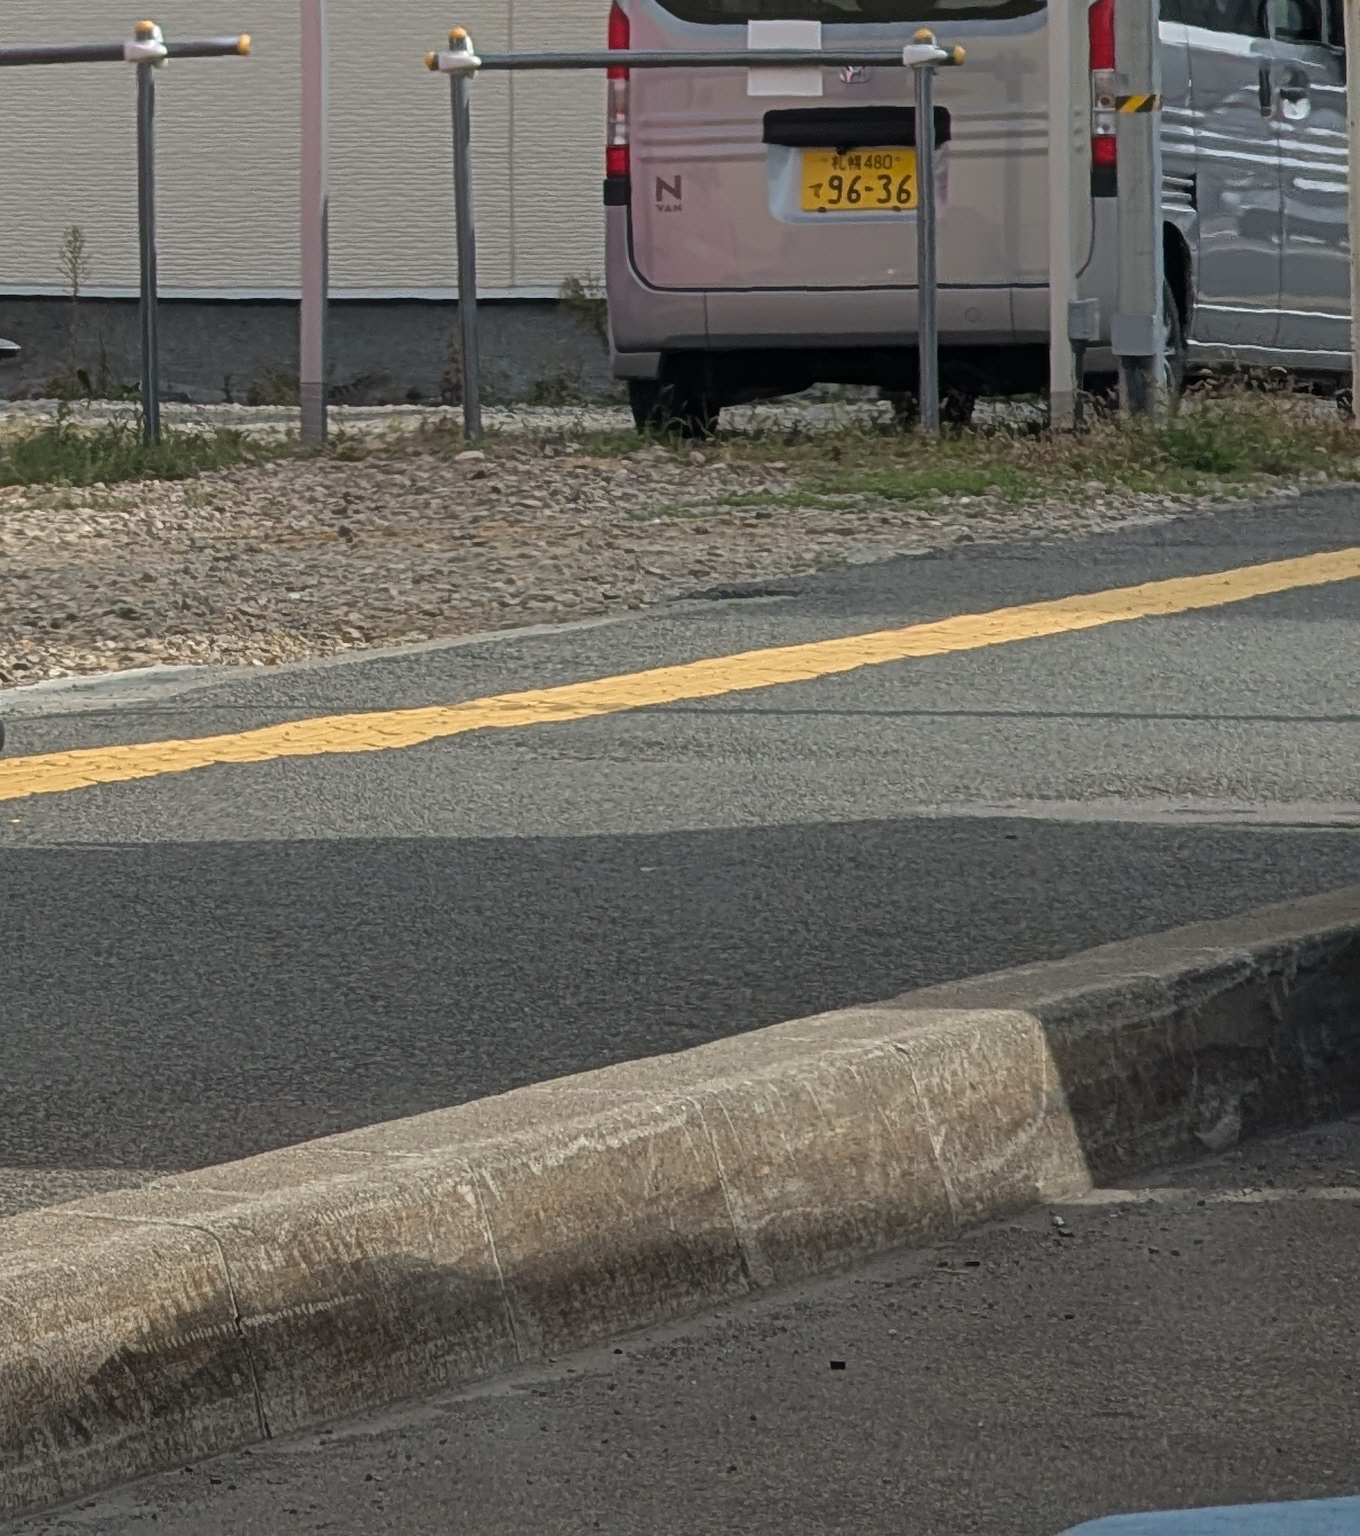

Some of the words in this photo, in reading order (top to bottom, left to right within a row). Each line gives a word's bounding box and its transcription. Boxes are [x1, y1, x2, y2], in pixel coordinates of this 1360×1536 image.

[864, 154, 893, 170] 480
[656, 175, 682, 202] N
[827, 174, 912, 204] 96-36
